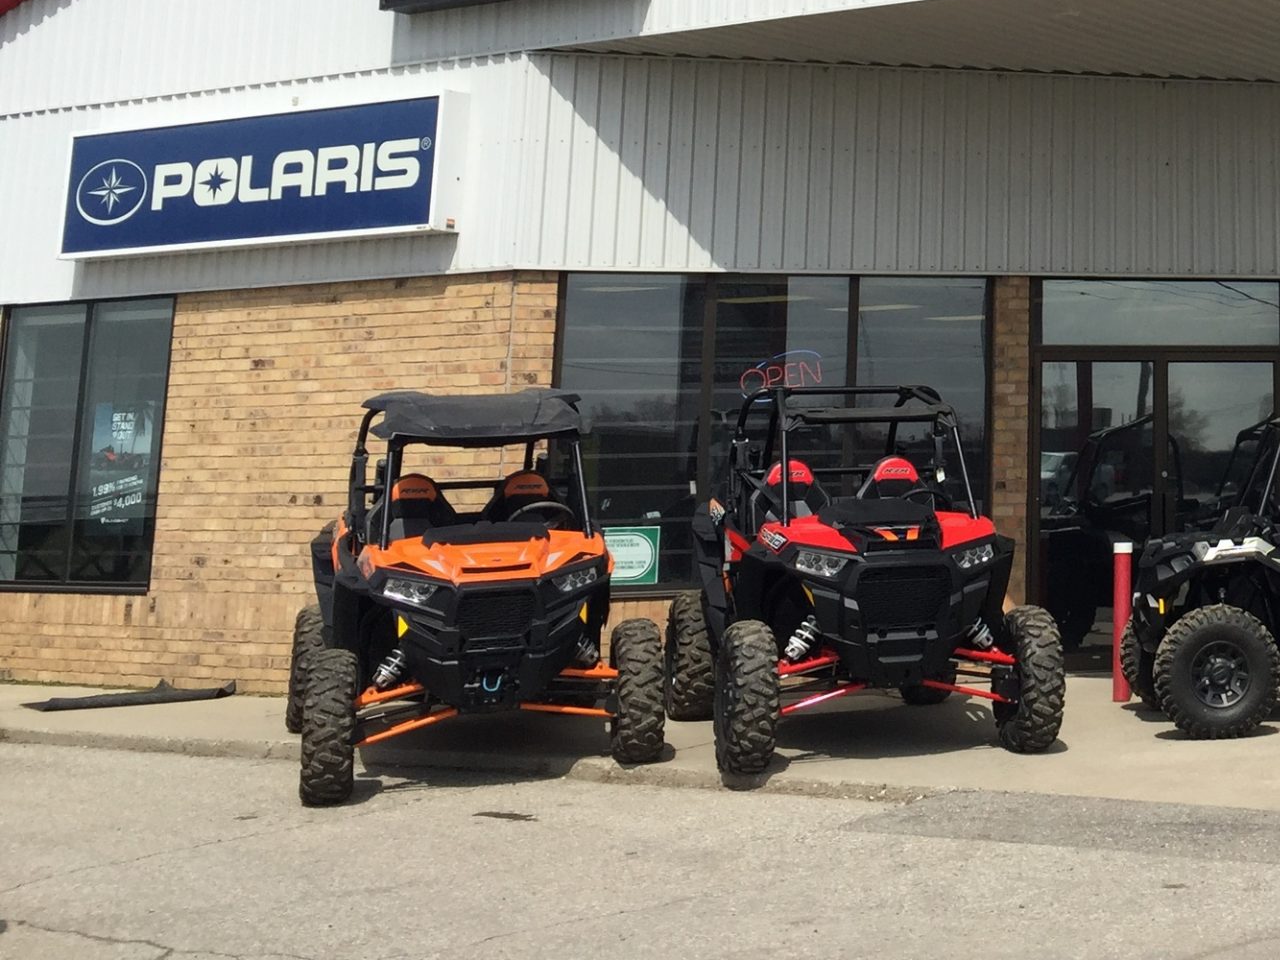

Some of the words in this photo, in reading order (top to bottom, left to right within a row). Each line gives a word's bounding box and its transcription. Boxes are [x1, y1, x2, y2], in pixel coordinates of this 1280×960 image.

[151, 137, 422, 211] POLARIS
[740, 361, 822, 394] OPEN
[112, 422, 135, 431] STAND
[92, 482, 115, 497] 1.99%
